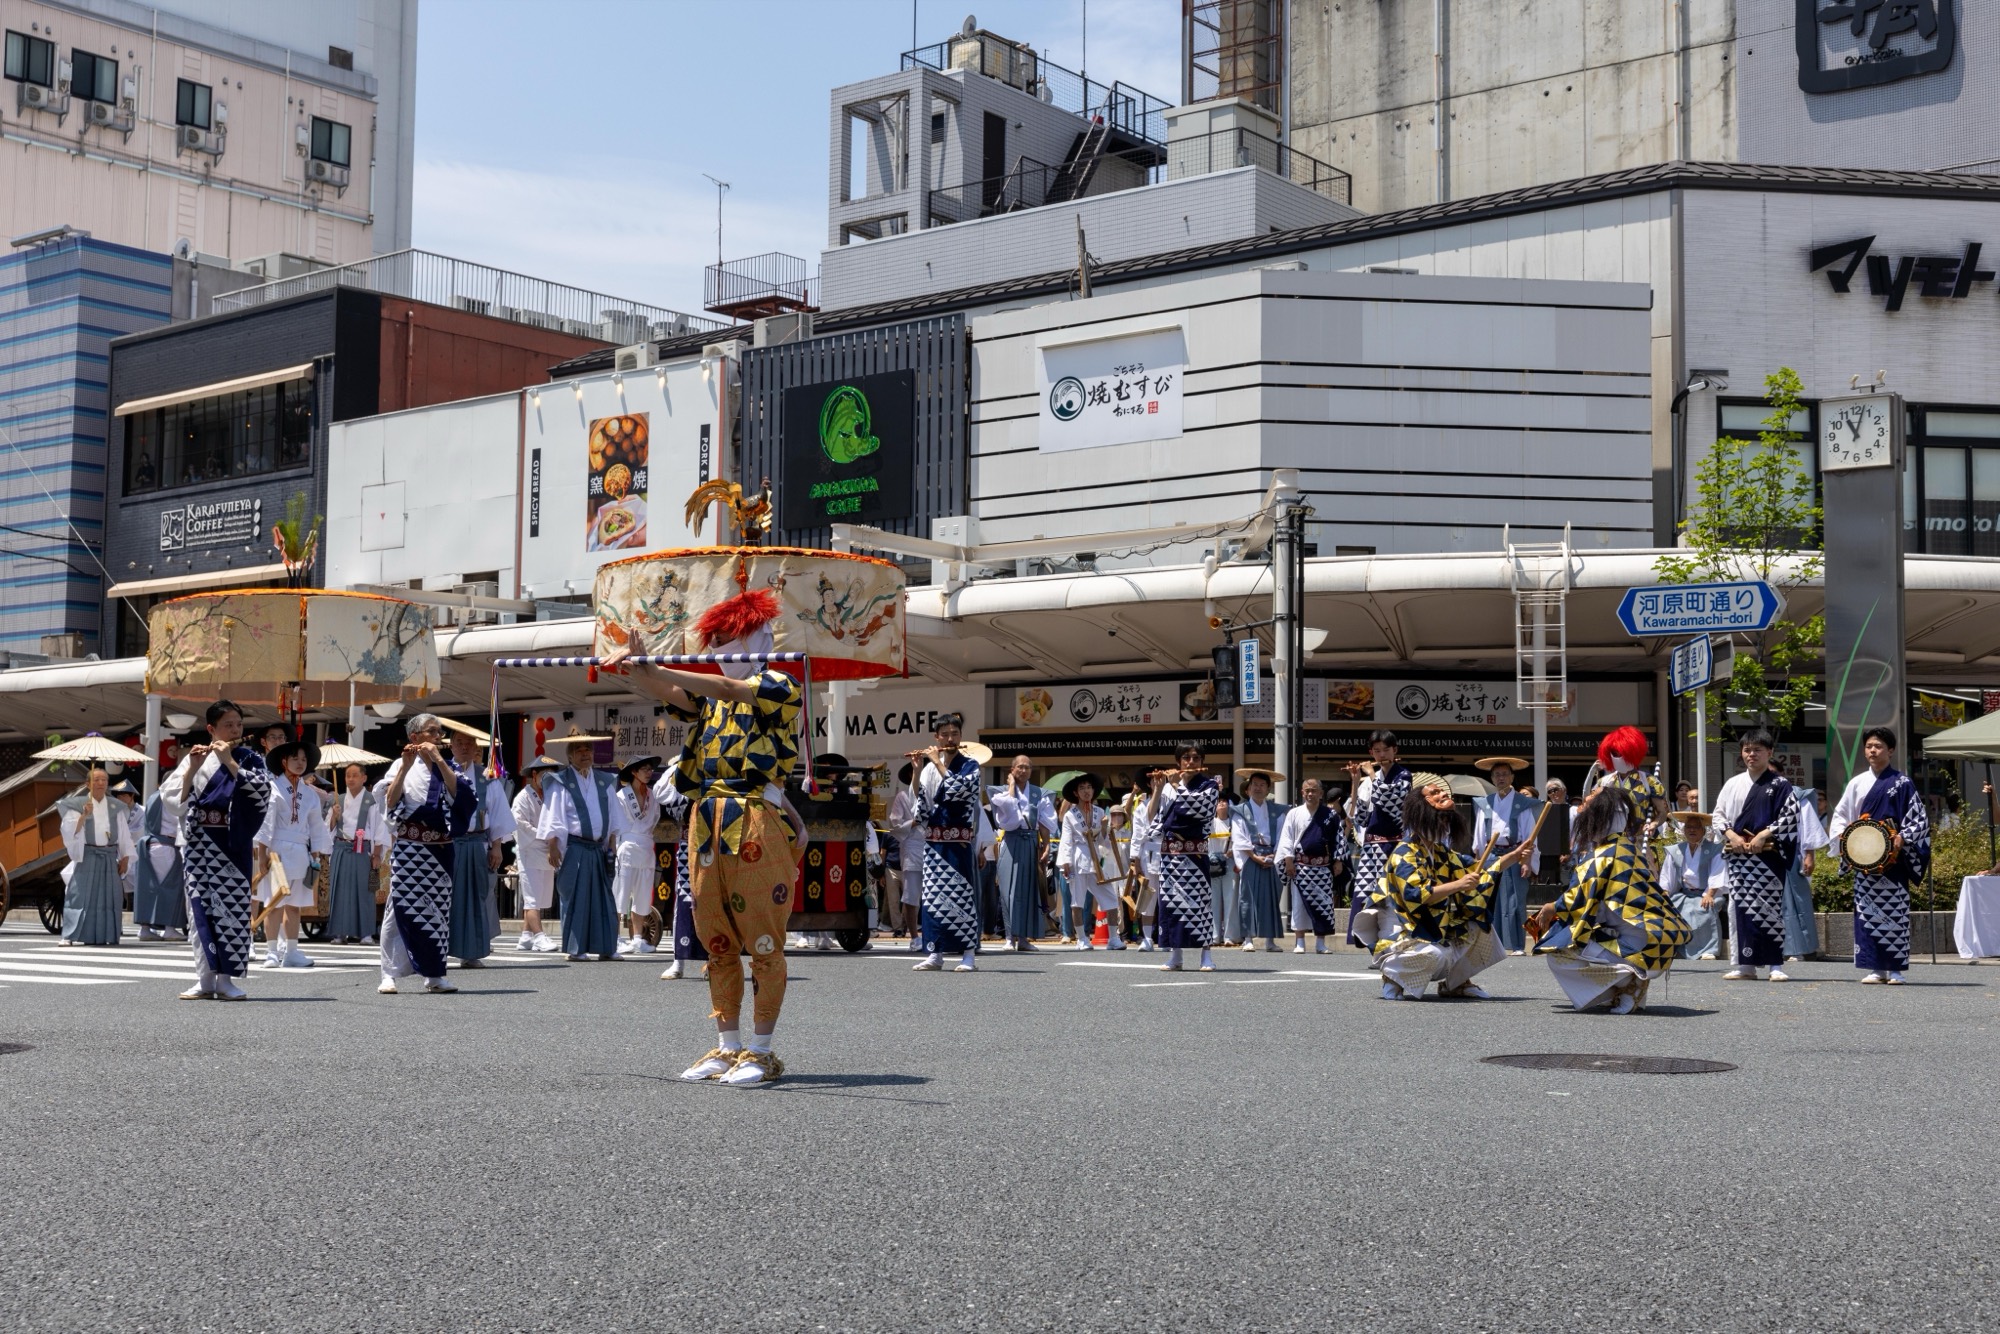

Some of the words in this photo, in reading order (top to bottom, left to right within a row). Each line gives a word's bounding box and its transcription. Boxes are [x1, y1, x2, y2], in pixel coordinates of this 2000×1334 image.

[1113, 362, 1145, 377] ごちそう
[1088, 374, 1173, 407] 焼むすび
[1839, 410, 1849, 420] 11
[1850, 405, 1861, 415] 12
[1866, 408, 1871, 418] 1
[1831, 420, 1843, 430] 10
[1873, 415, 1881, 425] 2
[1828, 432, 1836, 441] 9
[1877, 427, 1885, 437] 3
[701, 437, 709, 466] PORK
[1832, 443, 1840, 453] 8
[1873, 439, 1881, 449] 4
[1842, 450, 1850, 460] 7
[1853, 453, 1860, 462] 6
[1865, 448, 1872, 458] 5
[532, 459, 540, 493] BREAD
[187, 499, 252, 520] KARAFUNEYA
[826, 496, 862, 515] CAFE
[186, 518, 223, 533] COFFEE
[1639, 589, 1754, 616] 河原町通り
[1643, 611, 1753, 628] Kawaramachi-dori
[1244, 644, 1255, 700] 歩車分離信号
[1098, 694, 1162, 714] 焼むすび
[1431, 692, 1509, 712] 焼むすび
[884, 711, 938, 735] CAFE
